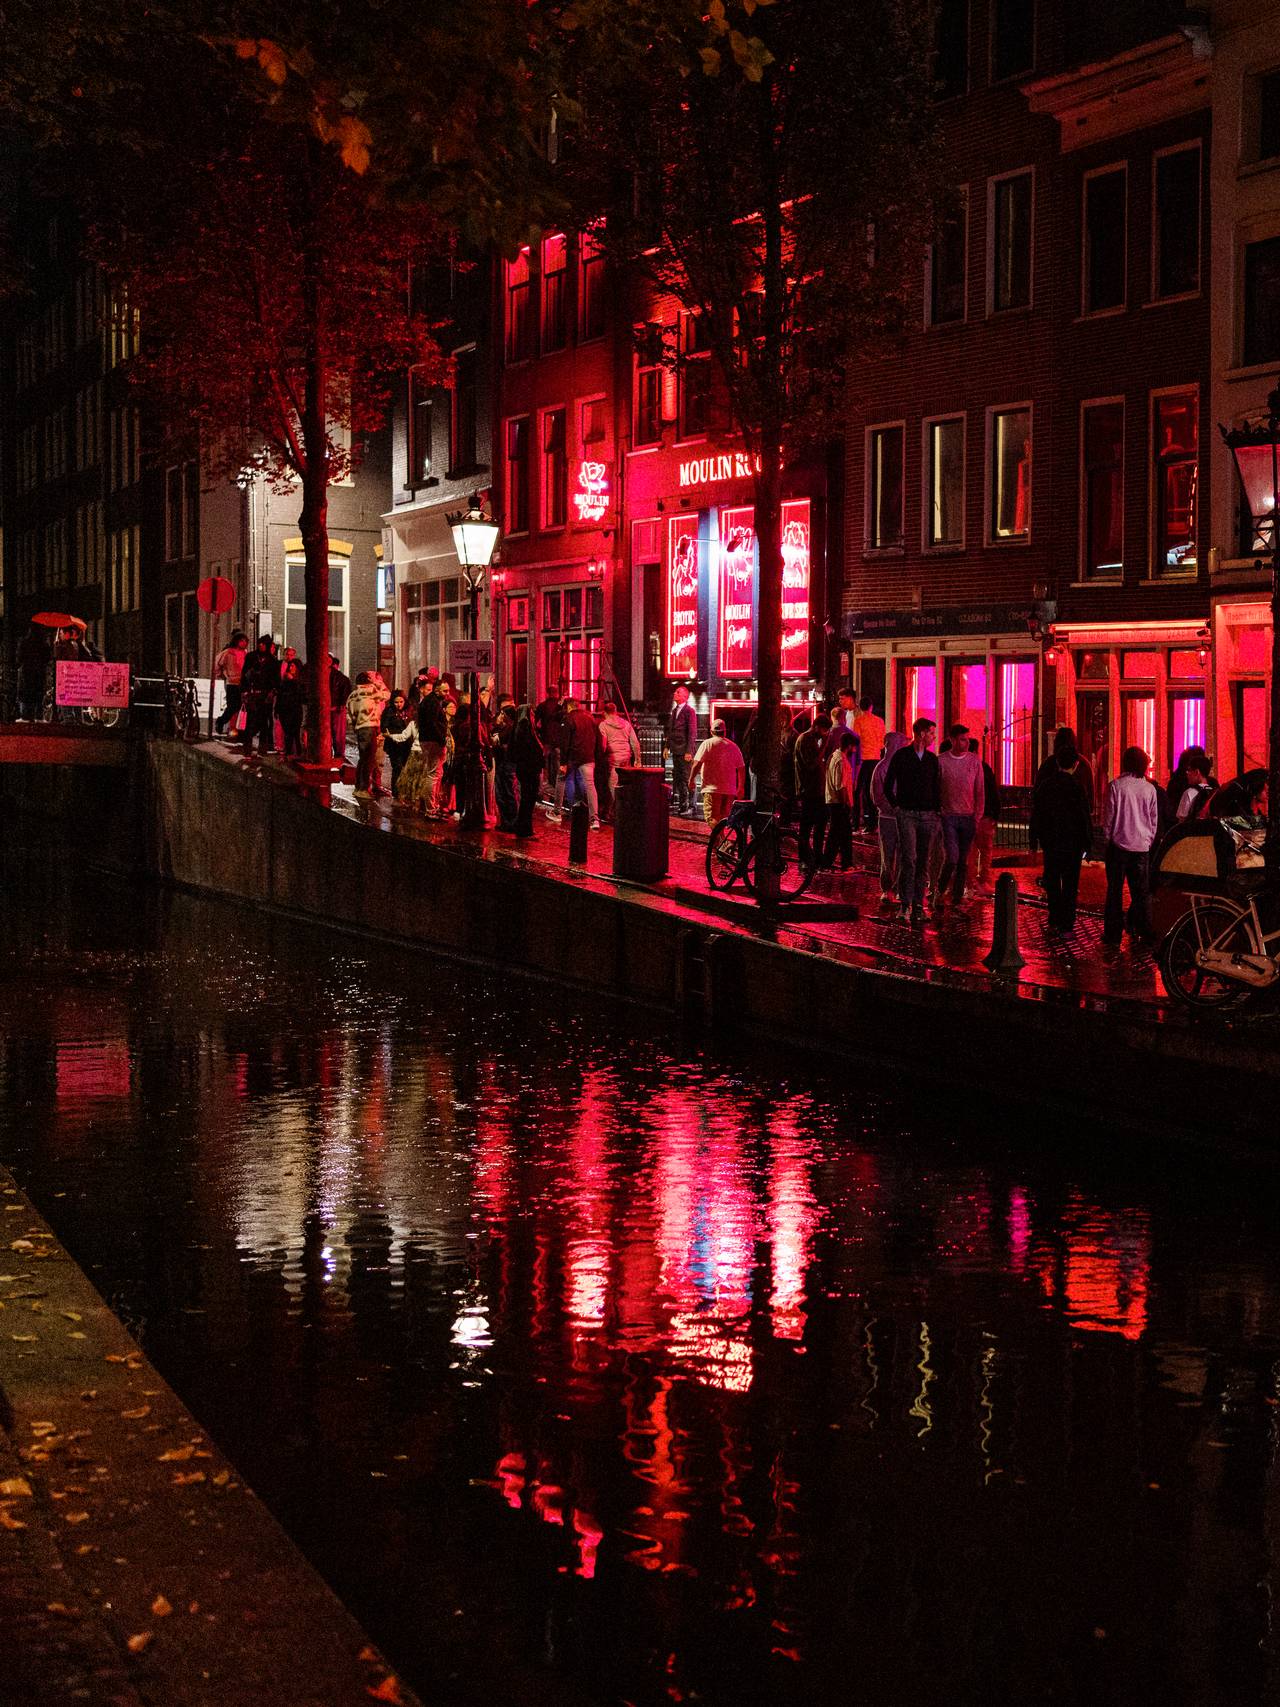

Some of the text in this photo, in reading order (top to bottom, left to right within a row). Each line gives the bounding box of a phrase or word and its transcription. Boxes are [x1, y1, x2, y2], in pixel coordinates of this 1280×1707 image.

[680, 455, 732, 486] MOULIN
[574, 494, 609, 506] MOULIN
[673, 610, 695, 626] EROTIC
[725, 604, 751, 620] MOULIN
